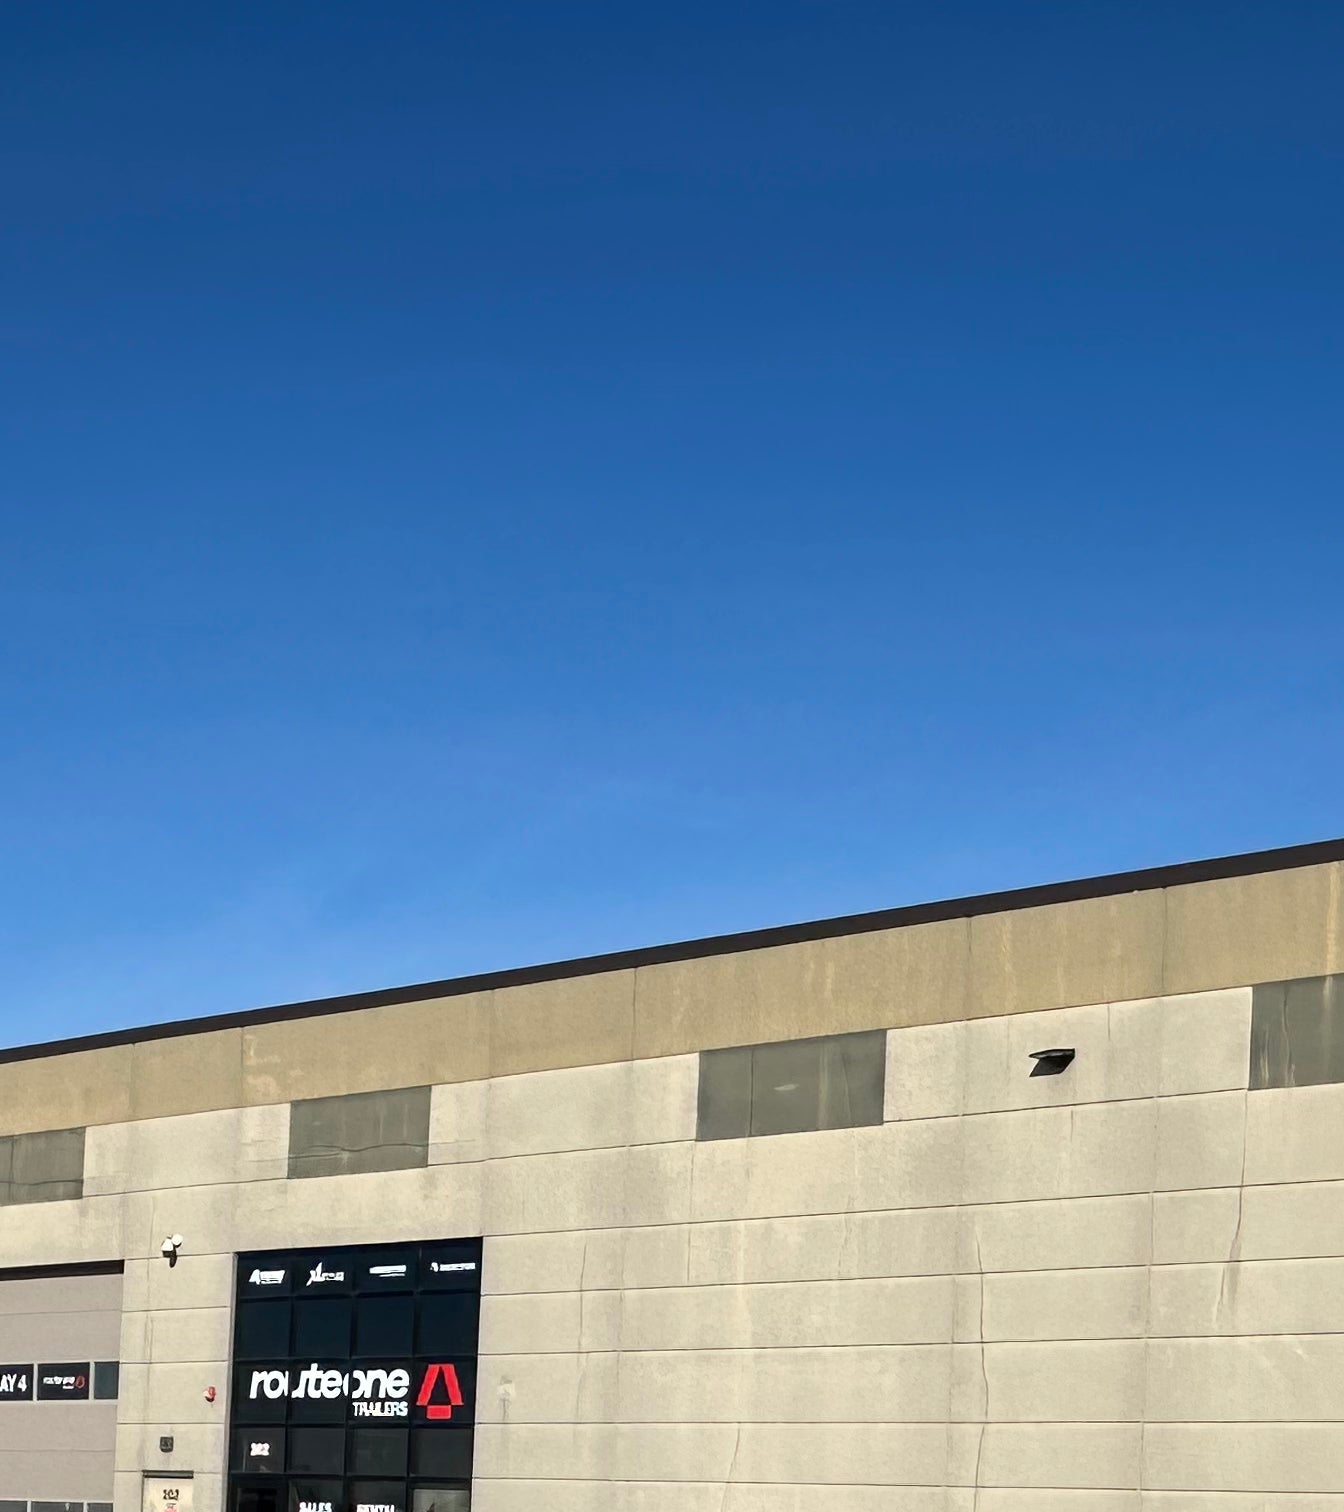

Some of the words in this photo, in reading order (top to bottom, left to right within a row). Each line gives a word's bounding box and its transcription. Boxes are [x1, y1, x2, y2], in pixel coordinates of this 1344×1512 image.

[17, 1374, 27, 1392] 4
[249, 1363, 410, 1400] routeone
[353, 1401, 408, 1417] TRAILERS
